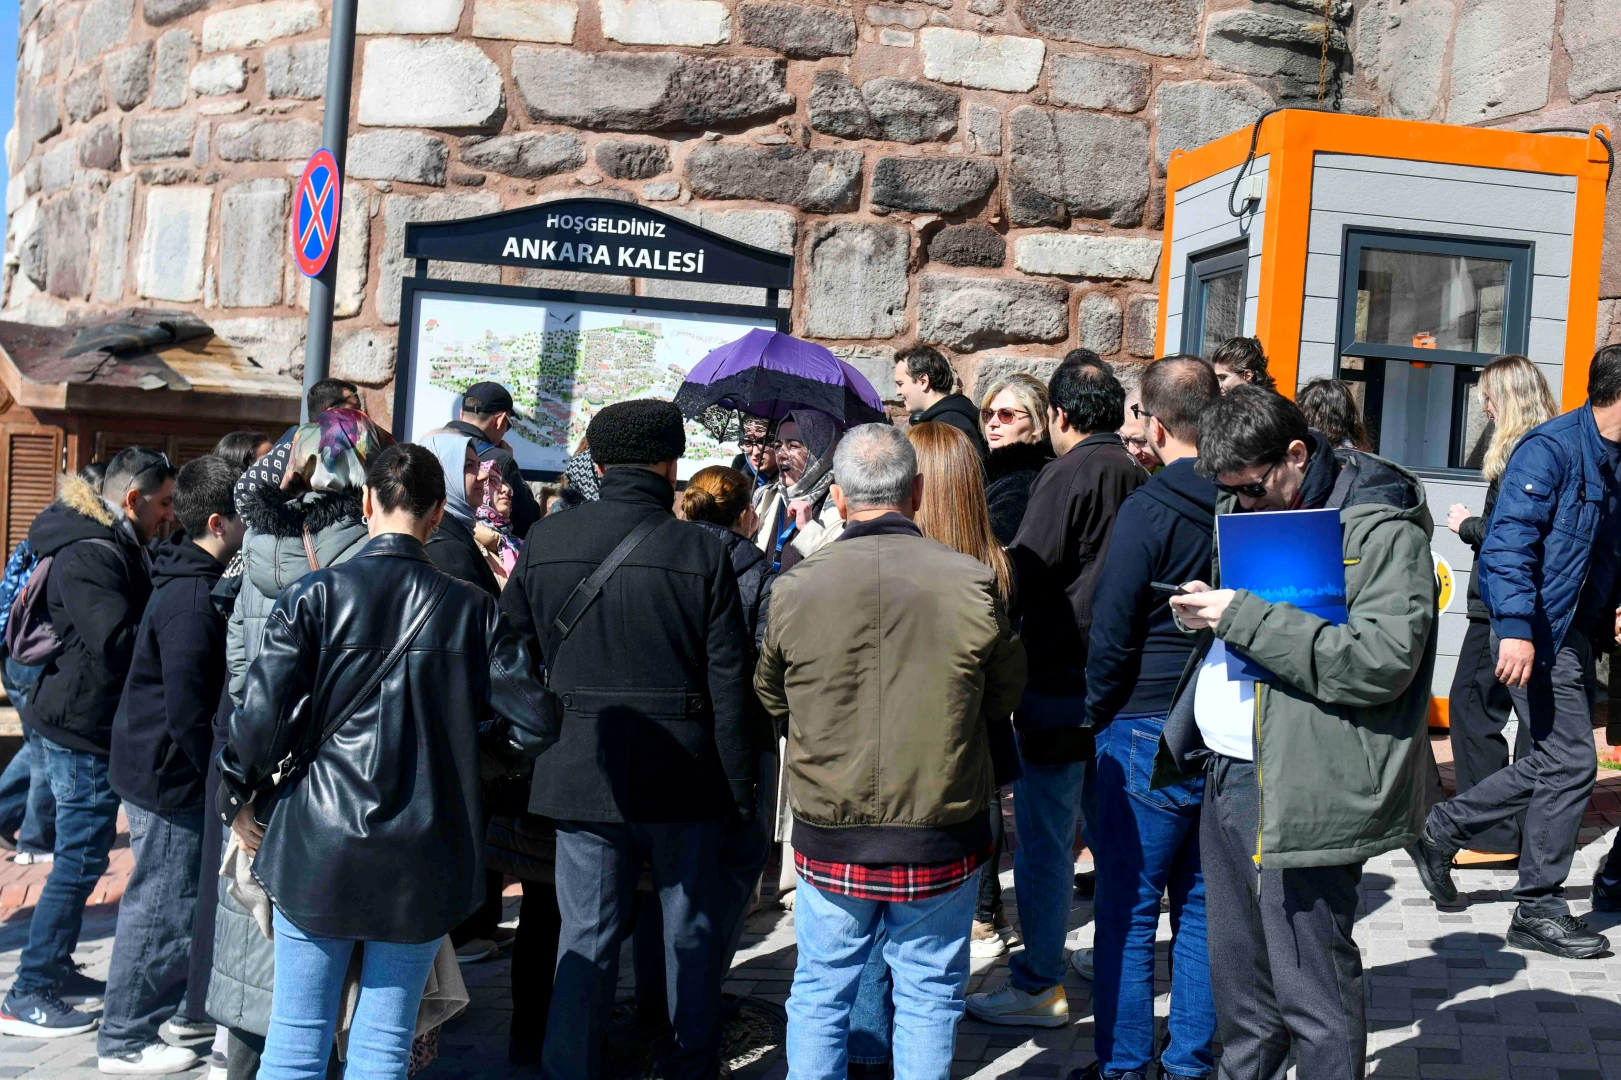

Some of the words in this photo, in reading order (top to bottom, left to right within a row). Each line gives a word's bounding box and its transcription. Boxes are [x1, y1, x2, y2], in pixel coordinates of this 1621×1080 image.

[546, 213, 666, 238] HOŞGELDİNİZ
[502, 237, 611, 266] ANKARA
[617, 247, 704, 274] KALESİ
